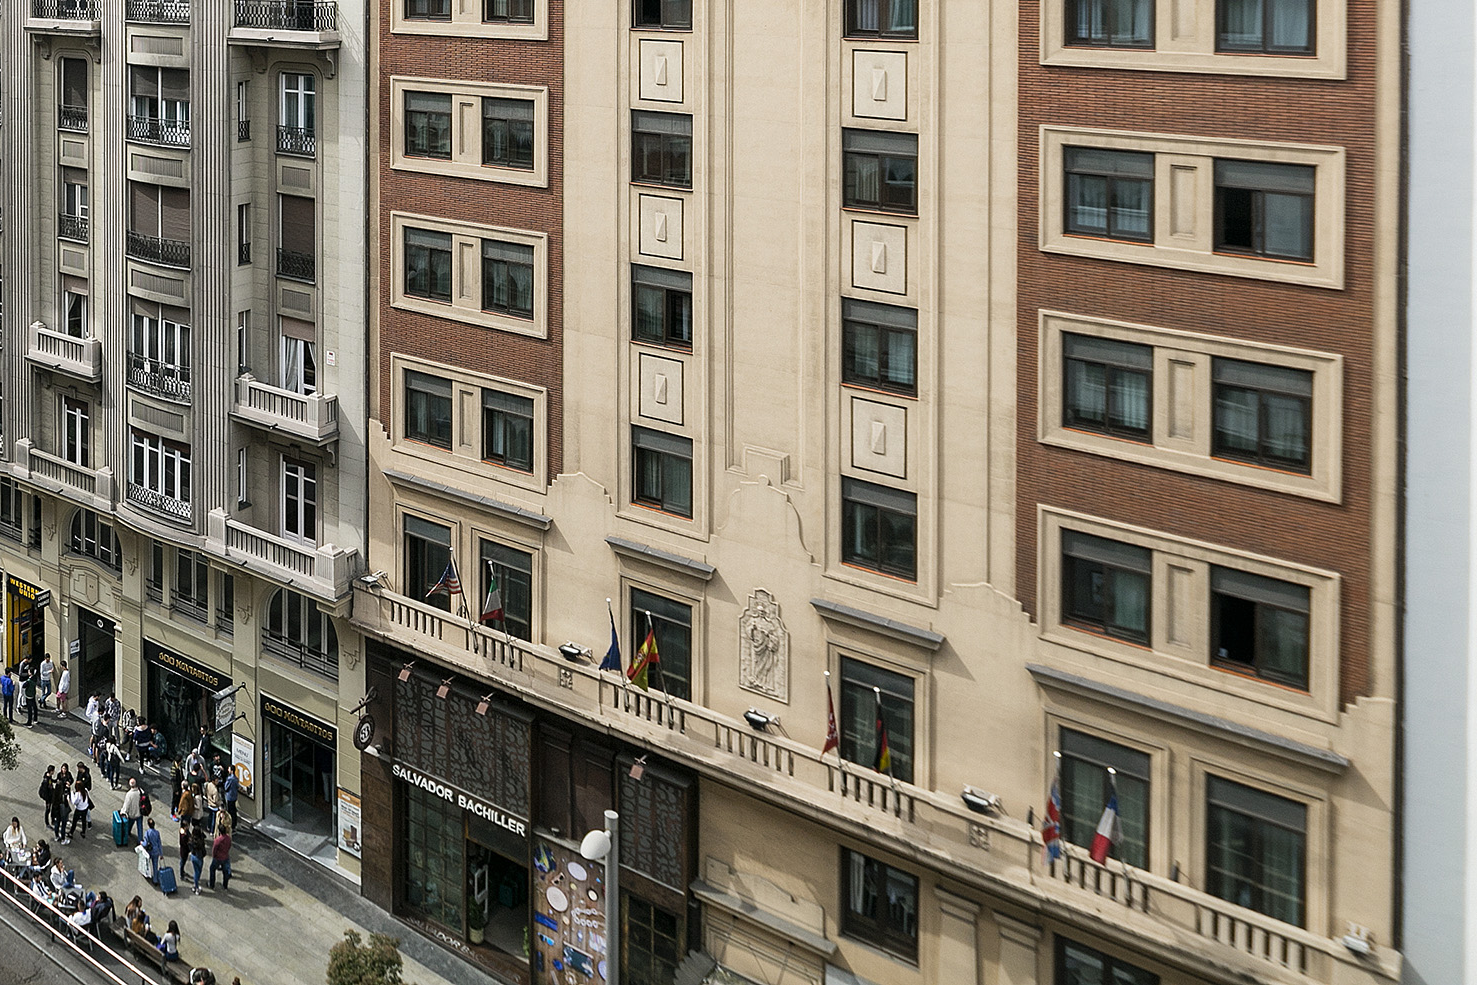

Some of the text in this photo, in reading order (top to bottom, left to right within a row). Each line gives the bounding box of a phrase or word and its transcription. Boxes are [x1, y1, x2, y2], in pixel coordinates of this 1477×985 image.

[18, 588, 36, 600] UNIO
[175, 659, 219, 687] MONTADITOS
[283, 710, 333, 741] MONTADITOS
[392, 765, 526, 837] SALVADOR BACHILLER
